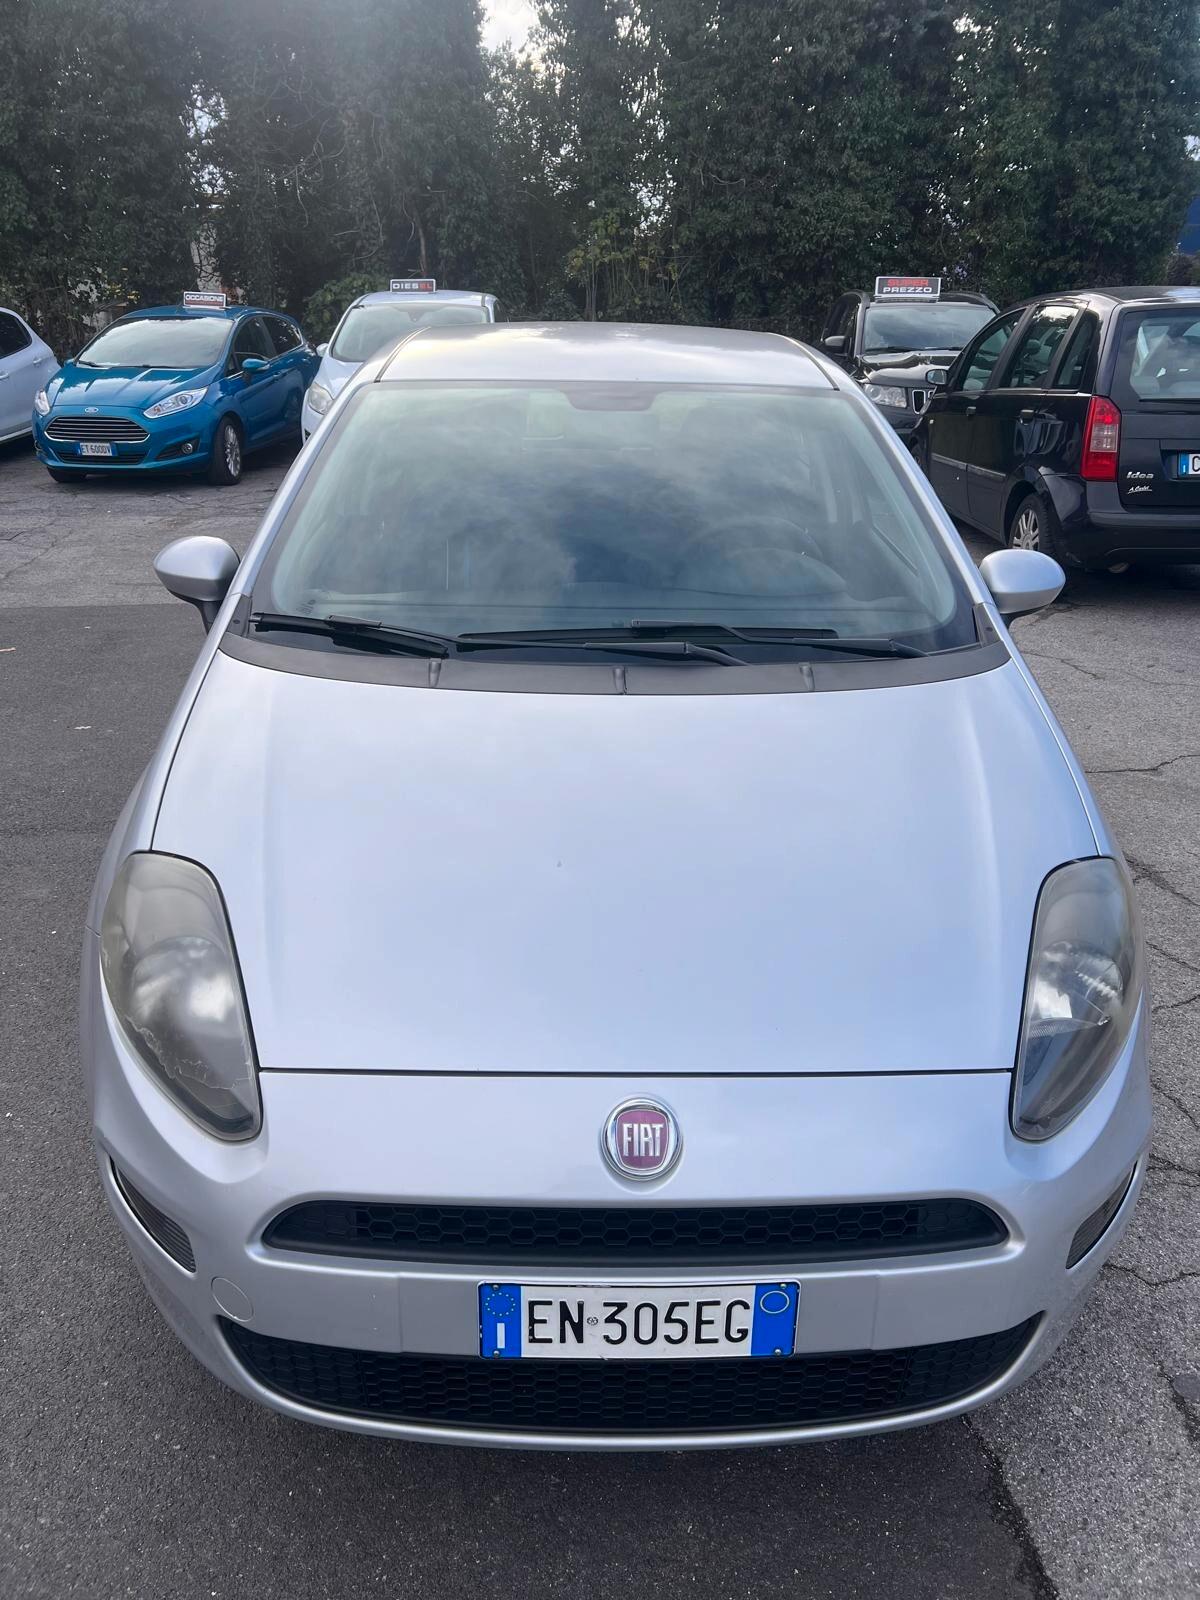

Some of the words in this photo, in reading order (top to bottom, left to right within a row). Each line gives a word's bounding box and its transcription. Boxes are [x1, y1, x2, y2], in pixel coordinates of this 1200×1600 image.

[888, 279, 928, 287] SUPER
[1126, 471, 1154, 479] Idea
[622, 1123, 664, 1157] FIAT
[528, 1299, 584, 1344] EN
[602, 1299, 751, 1345] 305EG
